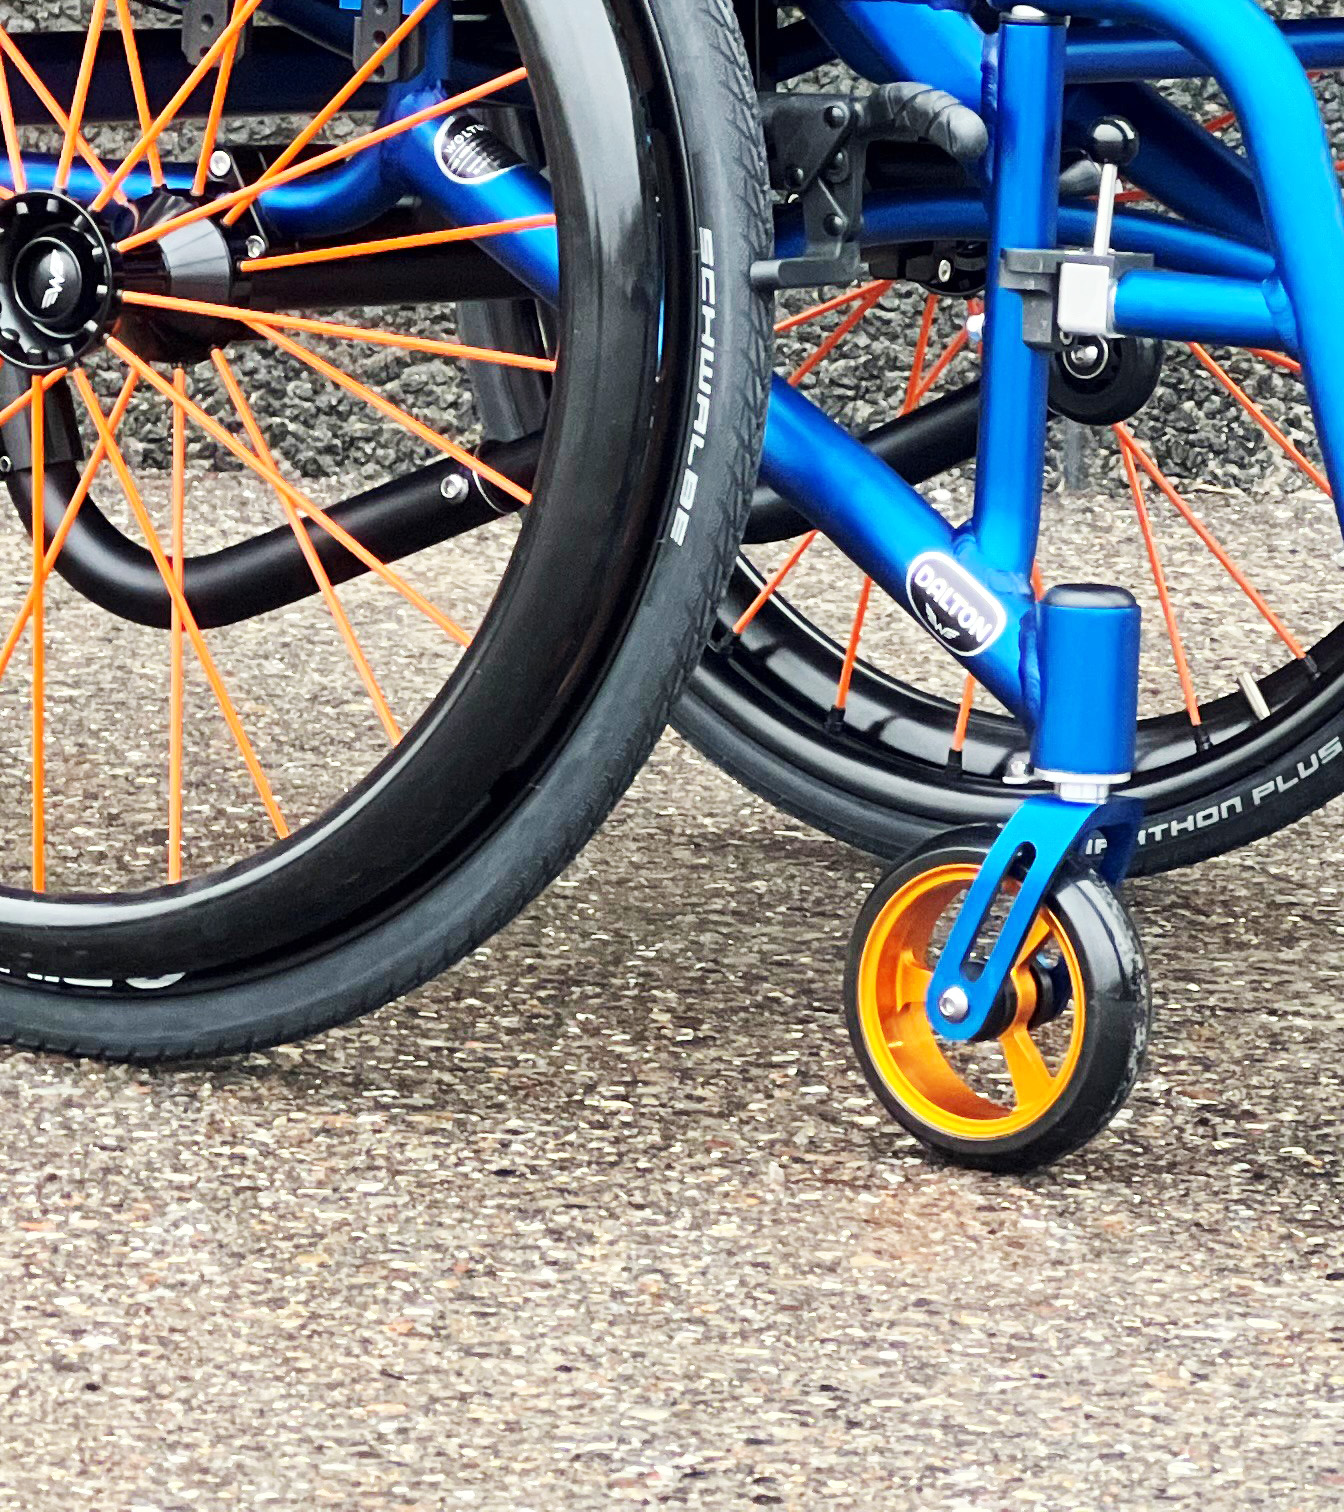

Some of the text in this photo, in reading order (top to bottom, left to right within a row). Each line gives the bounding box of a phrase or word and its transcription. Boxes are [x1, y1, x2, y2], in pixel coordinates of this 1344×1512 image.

[670, 227, 716, 547] SCHWALBE
[914, 565, 993, 643] DALTON
[1252, 736, 1343, 806] PLUS
